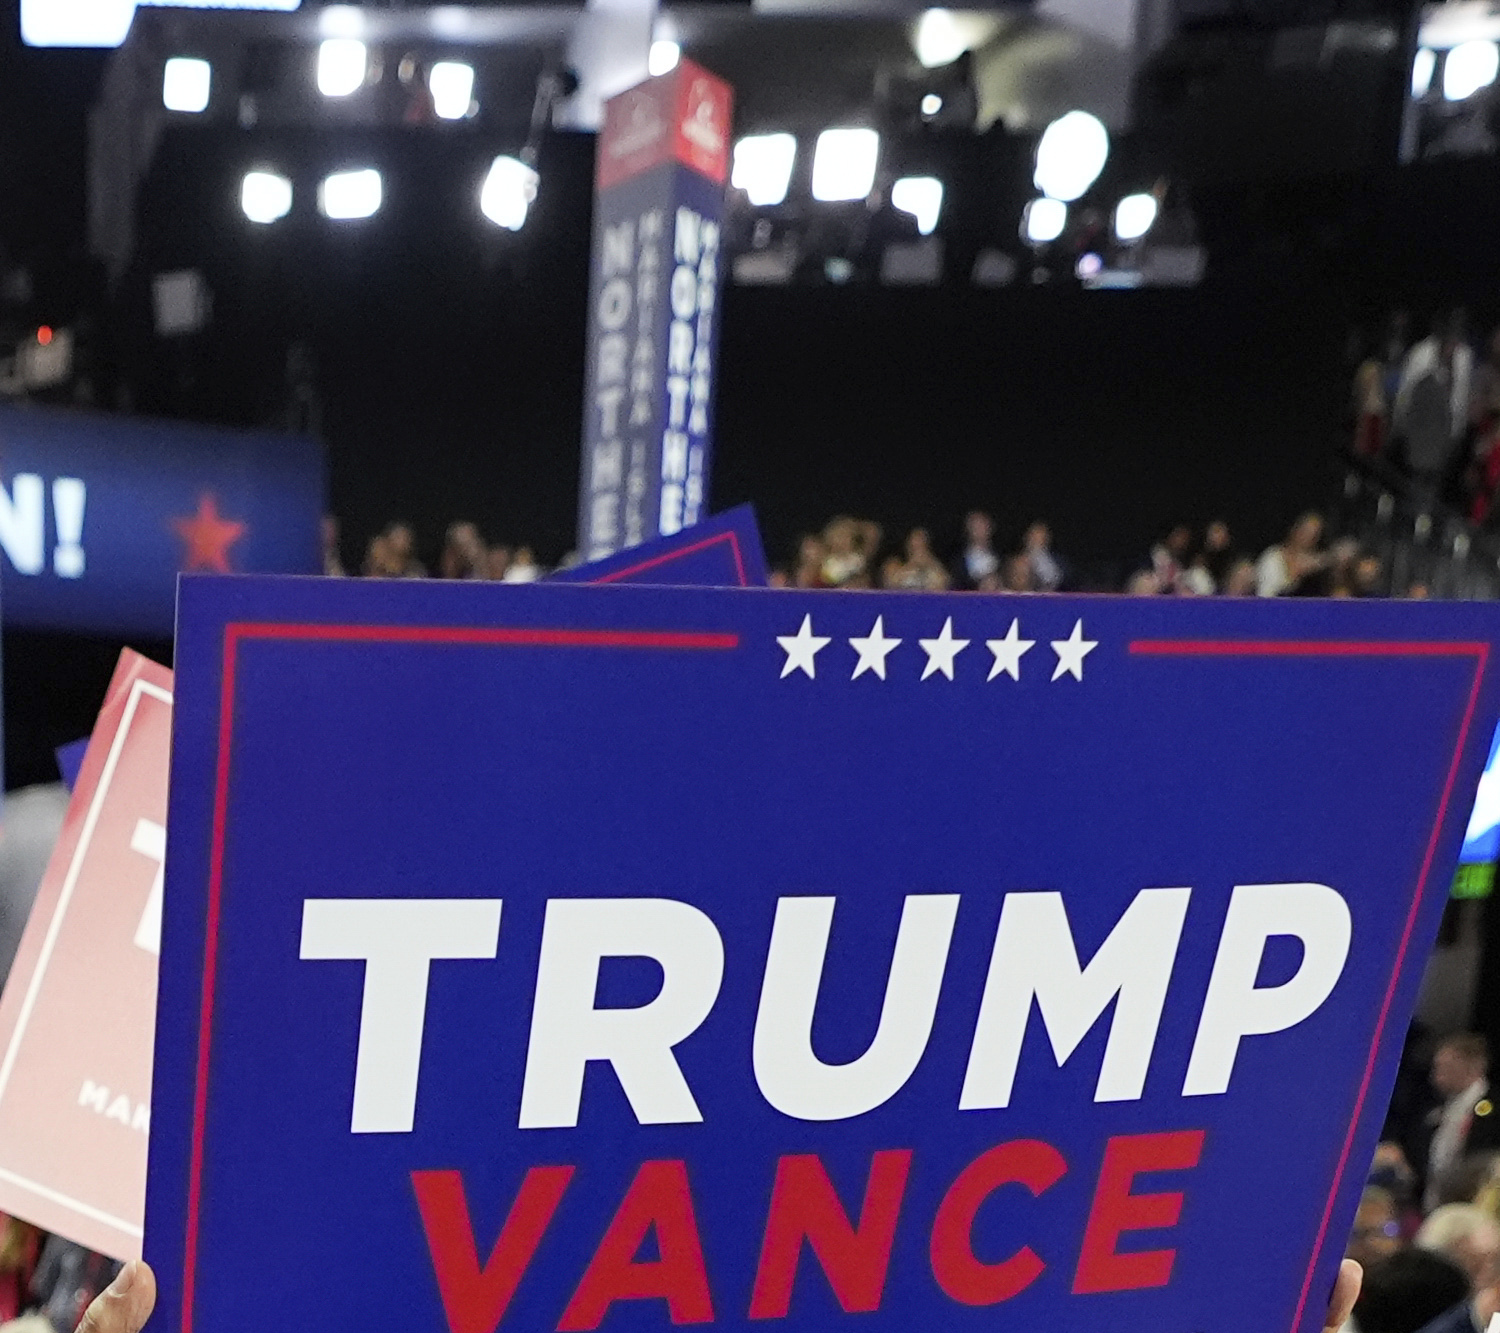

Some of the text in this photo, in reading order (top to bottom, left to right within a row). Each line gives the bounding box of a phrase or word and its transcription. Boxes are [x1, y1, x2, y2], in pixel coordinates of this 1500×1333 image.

[586, 221, 635, 562] NORTHE
[658, 205, 702, 537] NORTHE
[299, 882, 1352, 1134] TRUMP
